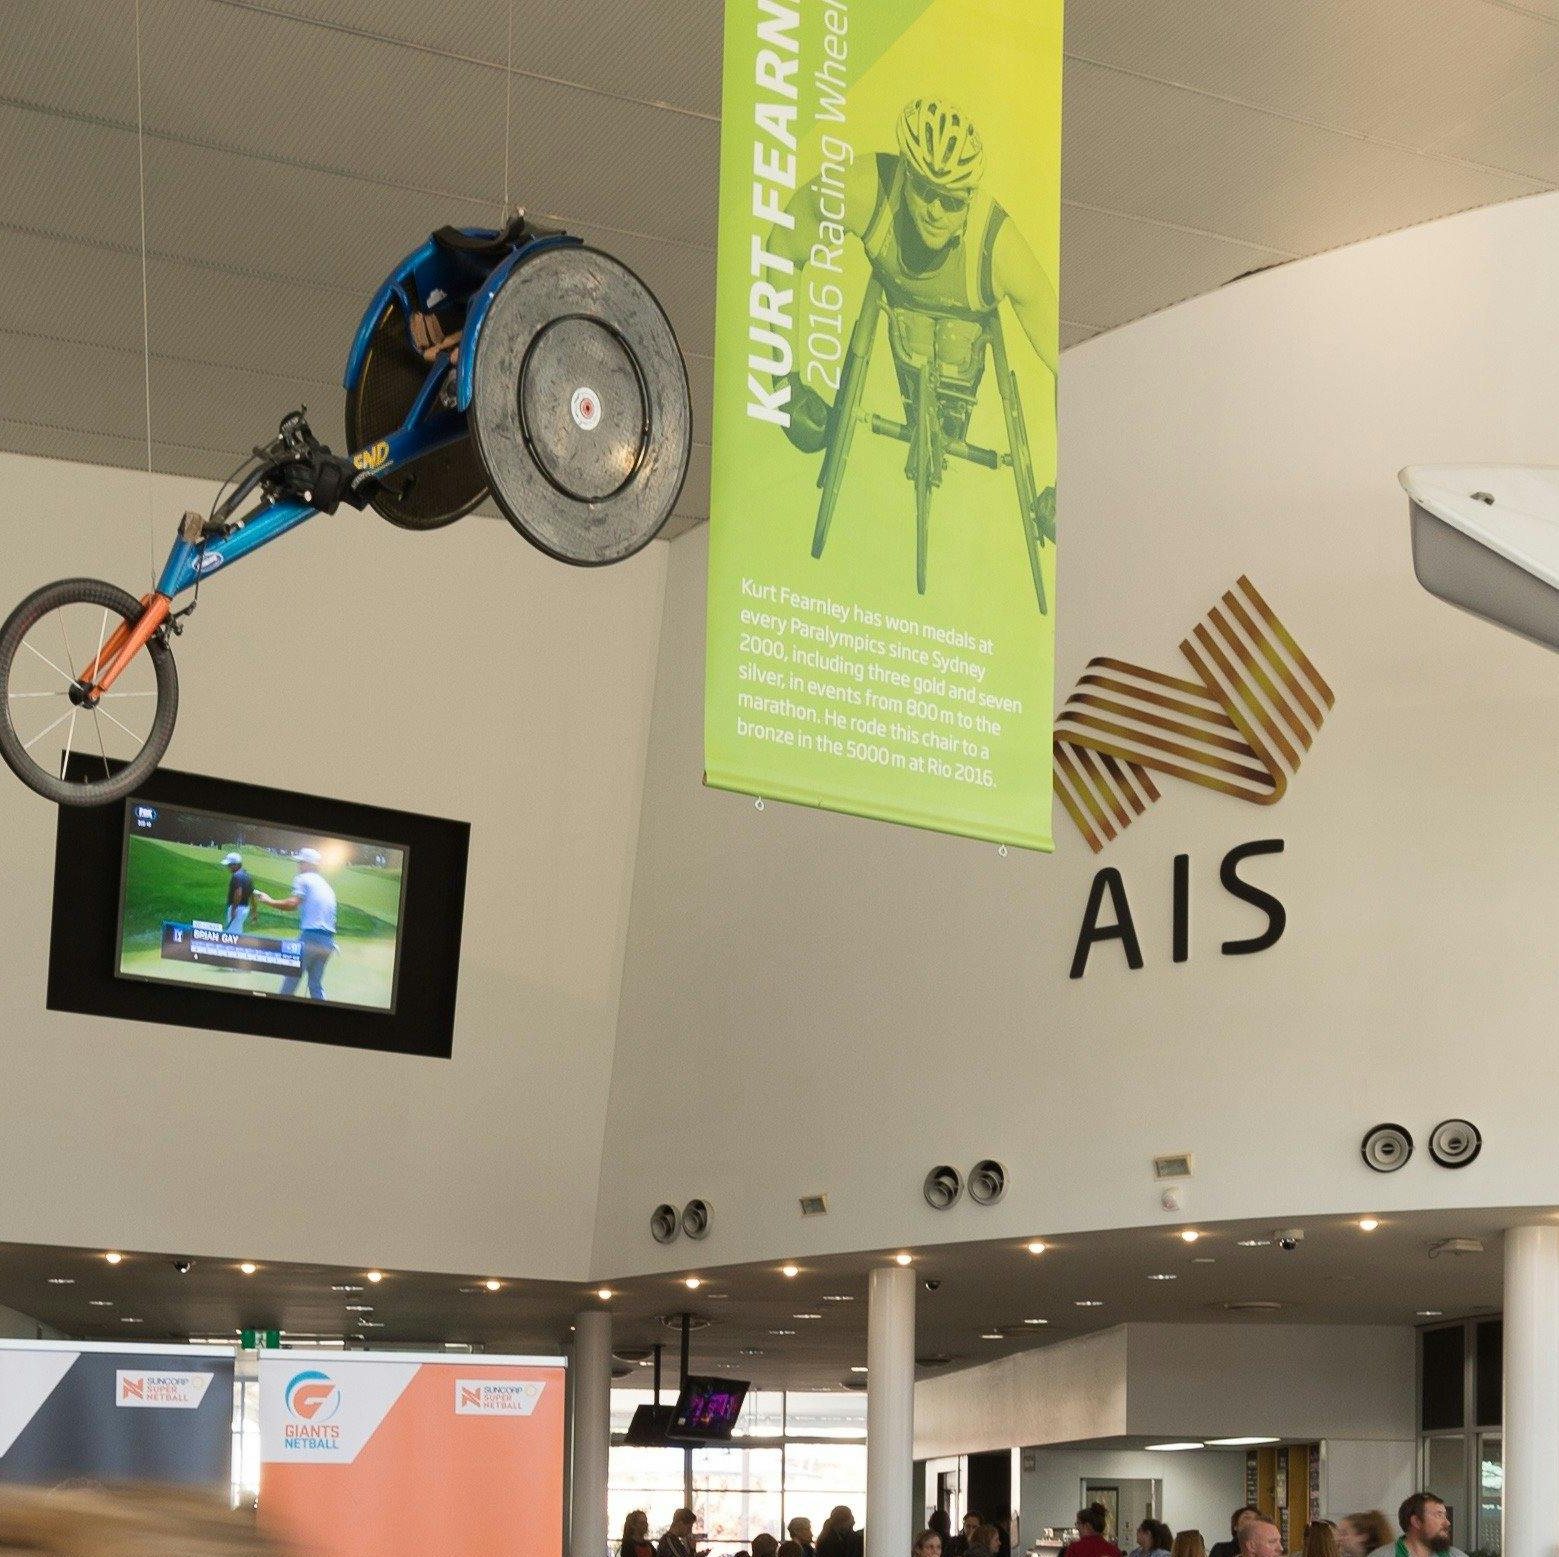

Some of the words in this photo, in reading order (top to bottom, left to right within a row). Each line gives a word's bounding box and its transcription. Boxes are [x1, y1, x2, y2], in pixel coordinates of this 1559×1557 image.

[752, 0, 801, 229] FEARN
[810, 136, 854, 274] Racing
[747, 235, 795, 428] KURT
[807, 281, 845, 391] 2016
[740, 608, 787, 636] every
[790, 617, 886, 656] Paralympics
[889, 641, 929, 665] since
[932, 651, 986, 683] Sydney
[741, 577, 777, 603] Kurt
[780, 588, 850, 622] Fearnley
[853, 602, 882, 627] has
[885, 613, 920, 635] won
[922, 622, 976, 650] medals
[977, 637, 994, 656] at
[738, 663, 786, 690] silver,
[789, 671, 805, 692] in
[808, 680, 861, 706] events
[865, 688, 903, 714] from
[956, 709, 972, 730] to
[976, 713, 1001, 737] the
[739, 633, 788, 662] 2000,
[792, 645, 864, 681] including
[867, 662, 911, 688] three
[913, 673, 946, 699] gold
[948, 677, 976, 703] and
[978, 690, 1022, 714] seven
[737, 717, 794, 746] bronze
[798, 727, 813, 750] in
[816, 731, 843, 756] the
[908, 754, 925, 773] at
[927, 758, 951, 778] Rio
[954, 764, 997, 788] 2016.
[738, 691, 821, 724] marathon.
[824, 704, 847, 729] He
[850, 712, 887, 738] rode
[889, 720, 919, 745] this
[922, 726, 960, 753] chair
[962, 739, 978, 758] to
[980, 745, 990, 760] a
[1069, 838, 1288, 979] AIS
[284, 1437, 339, 1450] NETBALL
[285, 1425, 339, 1439] GIANTS
